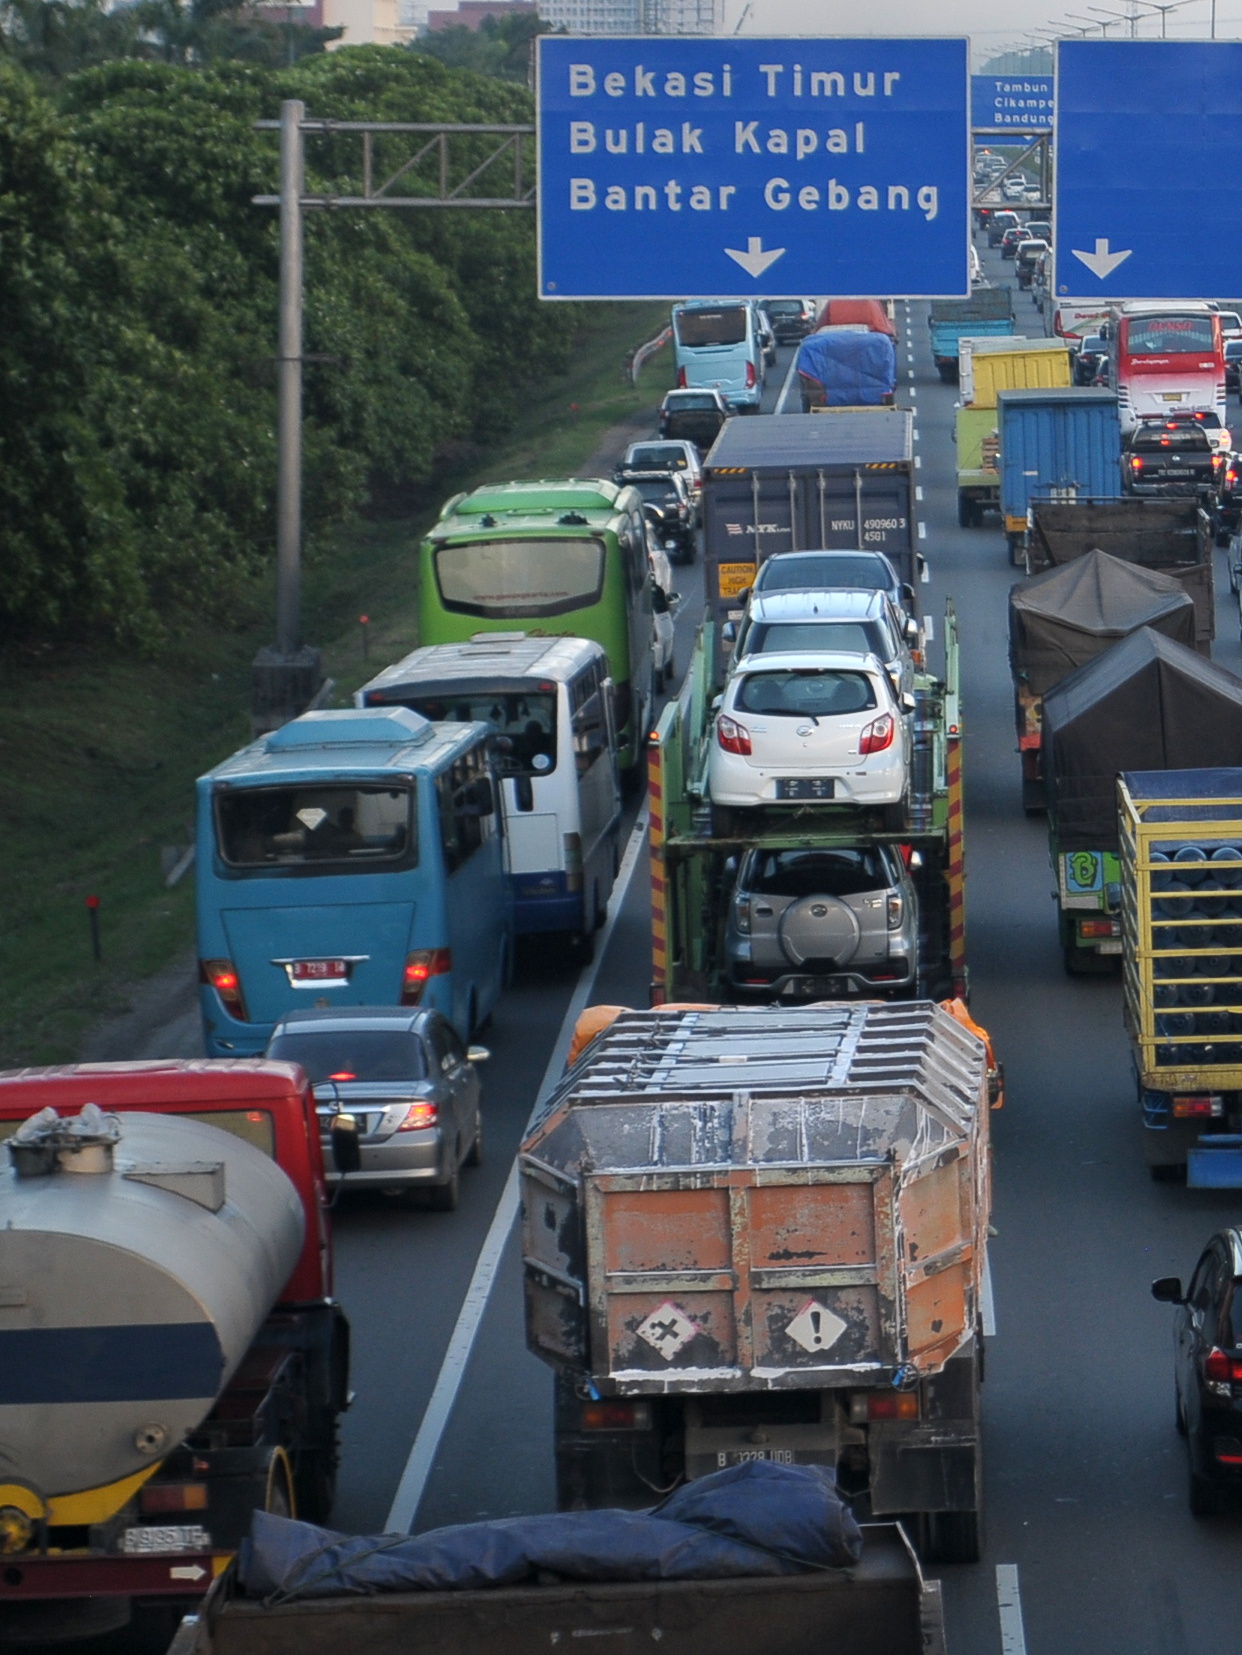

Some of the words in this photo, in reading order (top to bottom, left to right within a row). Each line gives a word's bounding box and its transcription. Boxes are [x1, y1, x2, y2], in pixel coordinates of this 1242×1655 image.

[570, 65, 730, 96] Bekasi
[760, 64, 899, 96] Timur
[995, 82, 1048, 92] Tambun
[994, 97, 1055, 109] Cikampe
[994, 113, 1055, 126] Bandung
[571, 122, 702, 153] Bulak
[736, 122, 863, 159] Kapal
[571, 179, 735, 210] Bantar
[765, 178, 937, 220] Gebang
[831, 520, 855, 530] NYKU
[864, 519, 897, 529] 490960
[721, 565, 754, 575] CAUTION
[718, 1452, 726, 1467] B
